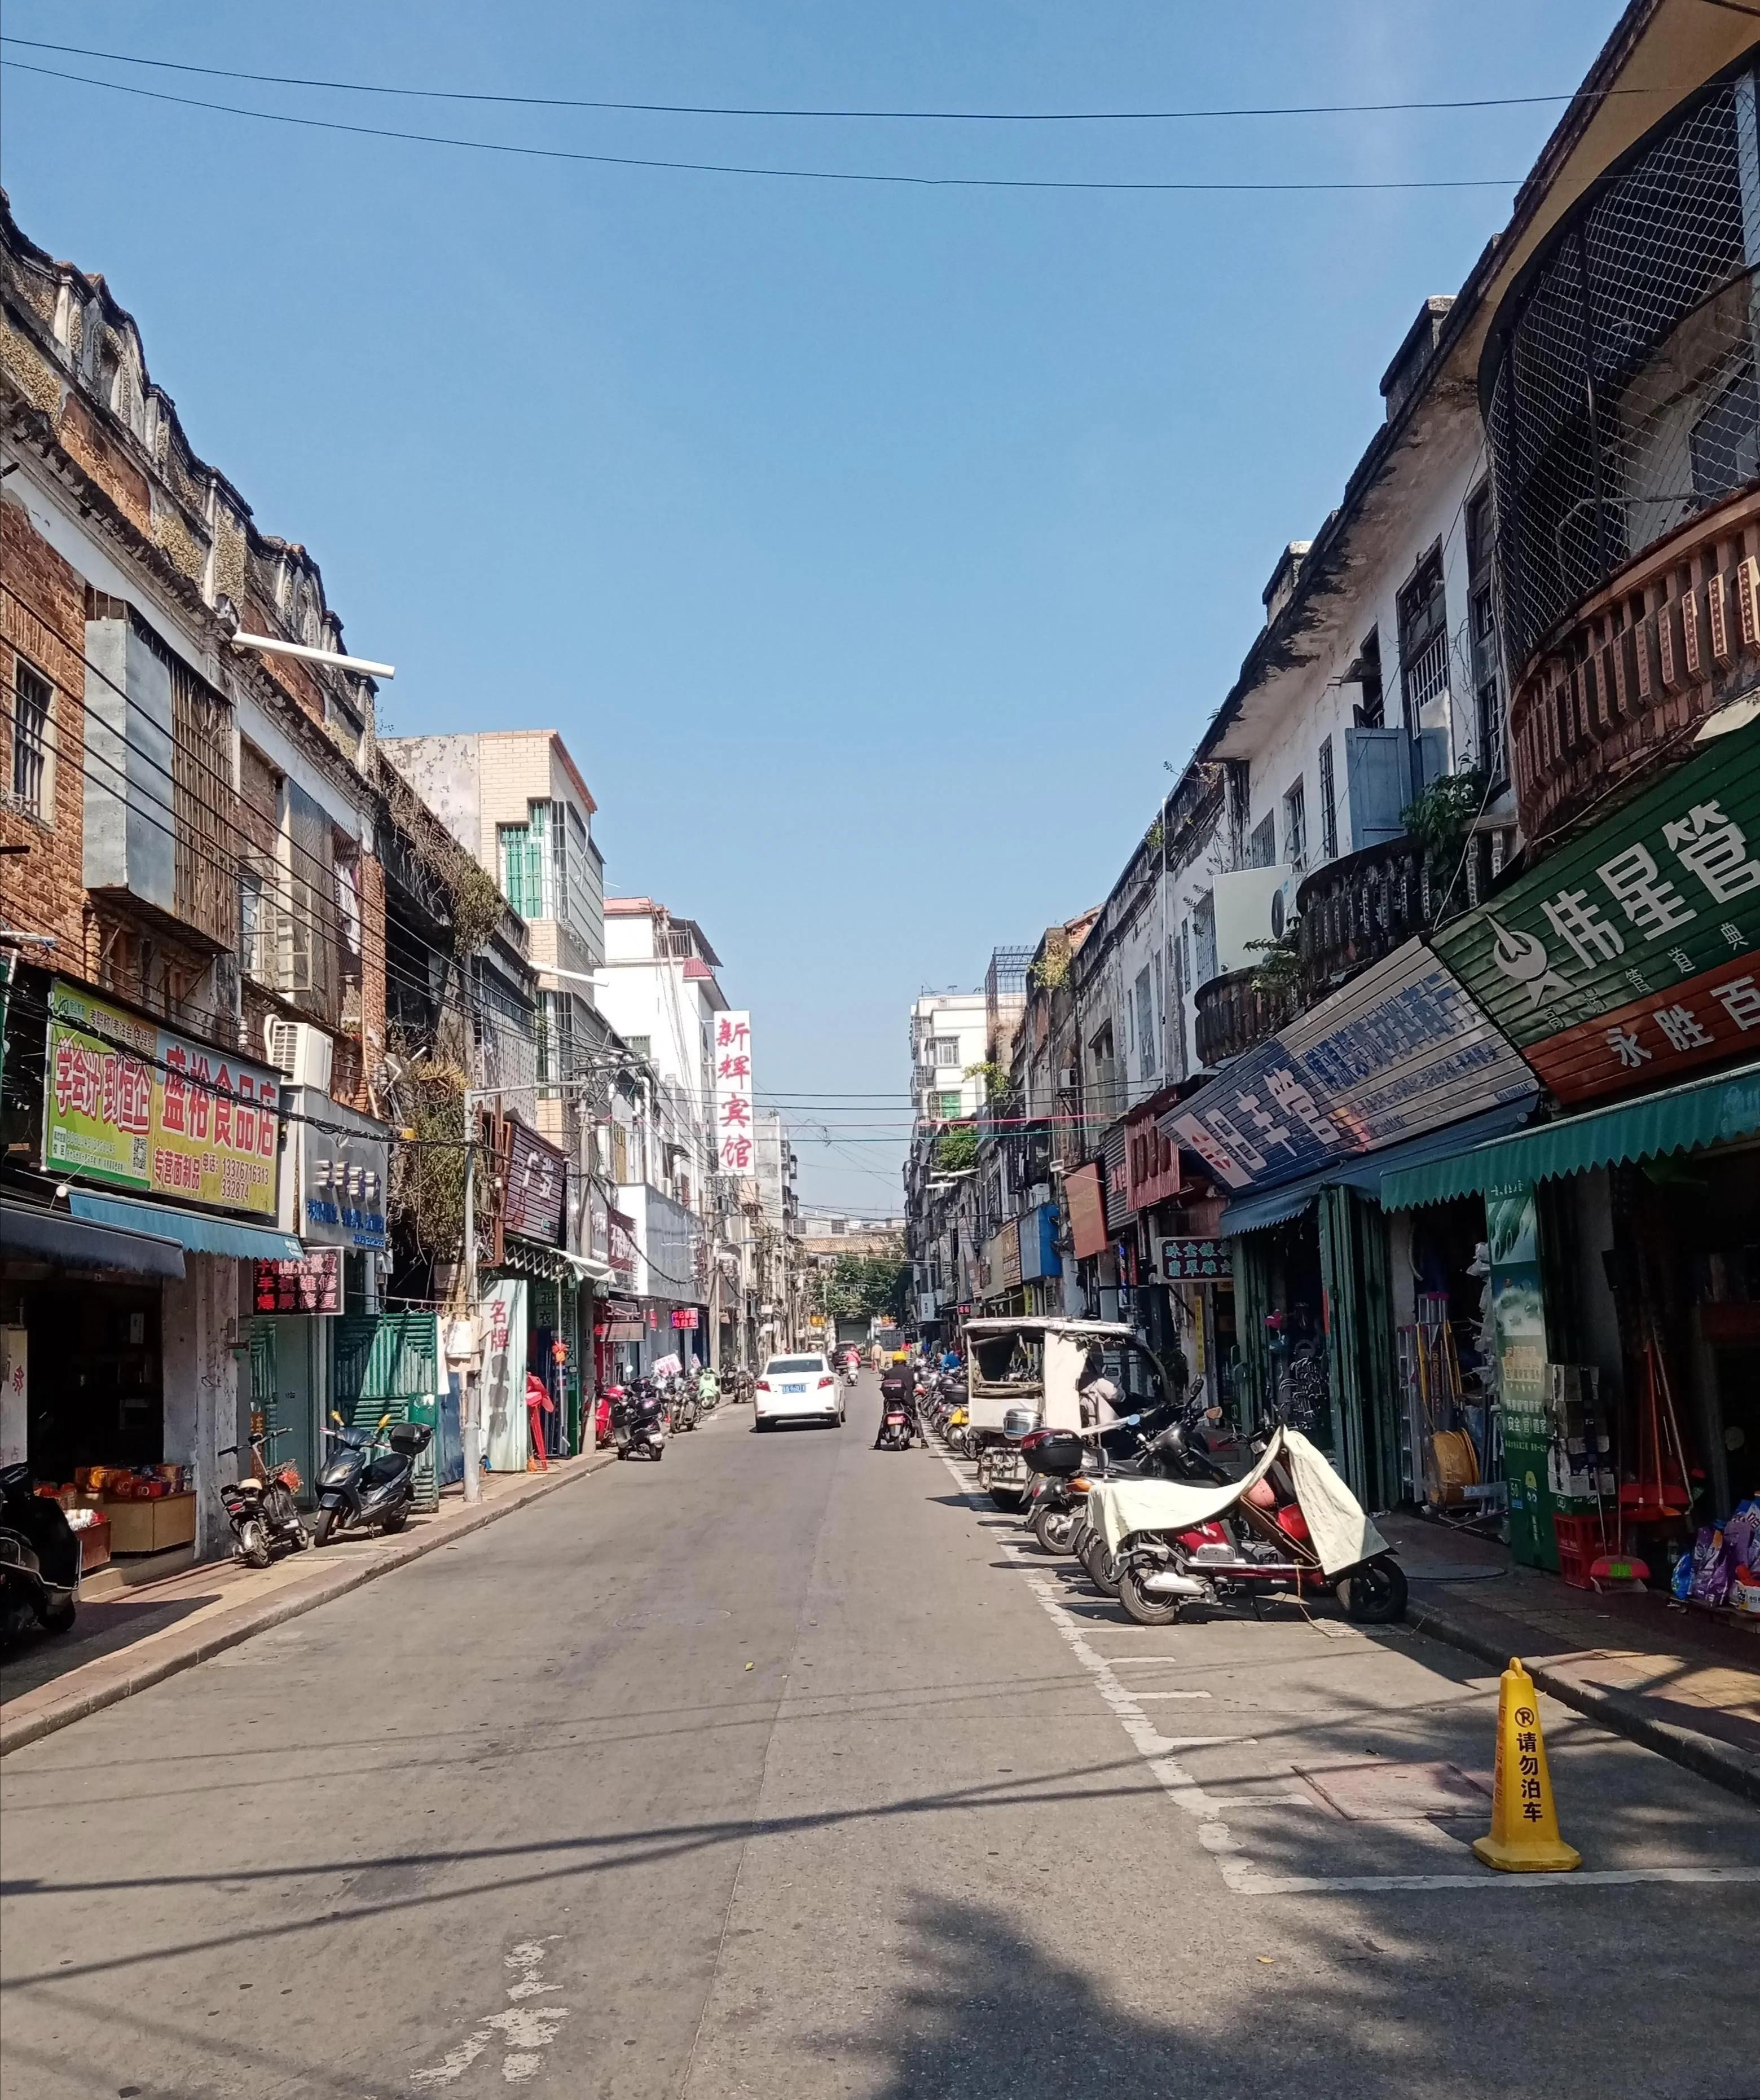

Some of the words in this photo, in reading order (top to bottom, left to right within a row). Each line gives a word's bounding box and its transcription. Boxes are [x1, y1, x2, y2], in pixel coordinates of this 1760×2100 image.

[1541, 800, 1760, 970] 伟星管
[1607, 976, 1760, 1067] 永胜百
[162, 1045, 276, 1156] 盛裕食品店
[716, 1018, 751, 1168] 新辉宾馆
[1205, 1068, 1340, 1170] 日丰管
[154, 1148, 200, 1190] 专营面制品
[221, 1178, 249, 1201] 332874
[222, 1157, 269, 1185] 13376716313
[258, 1275, 337, 1292] 手机维修
[490, 1299, 509, 1351] 名牌
[1516, 1731, 1543, 1822] 请勿泊车
